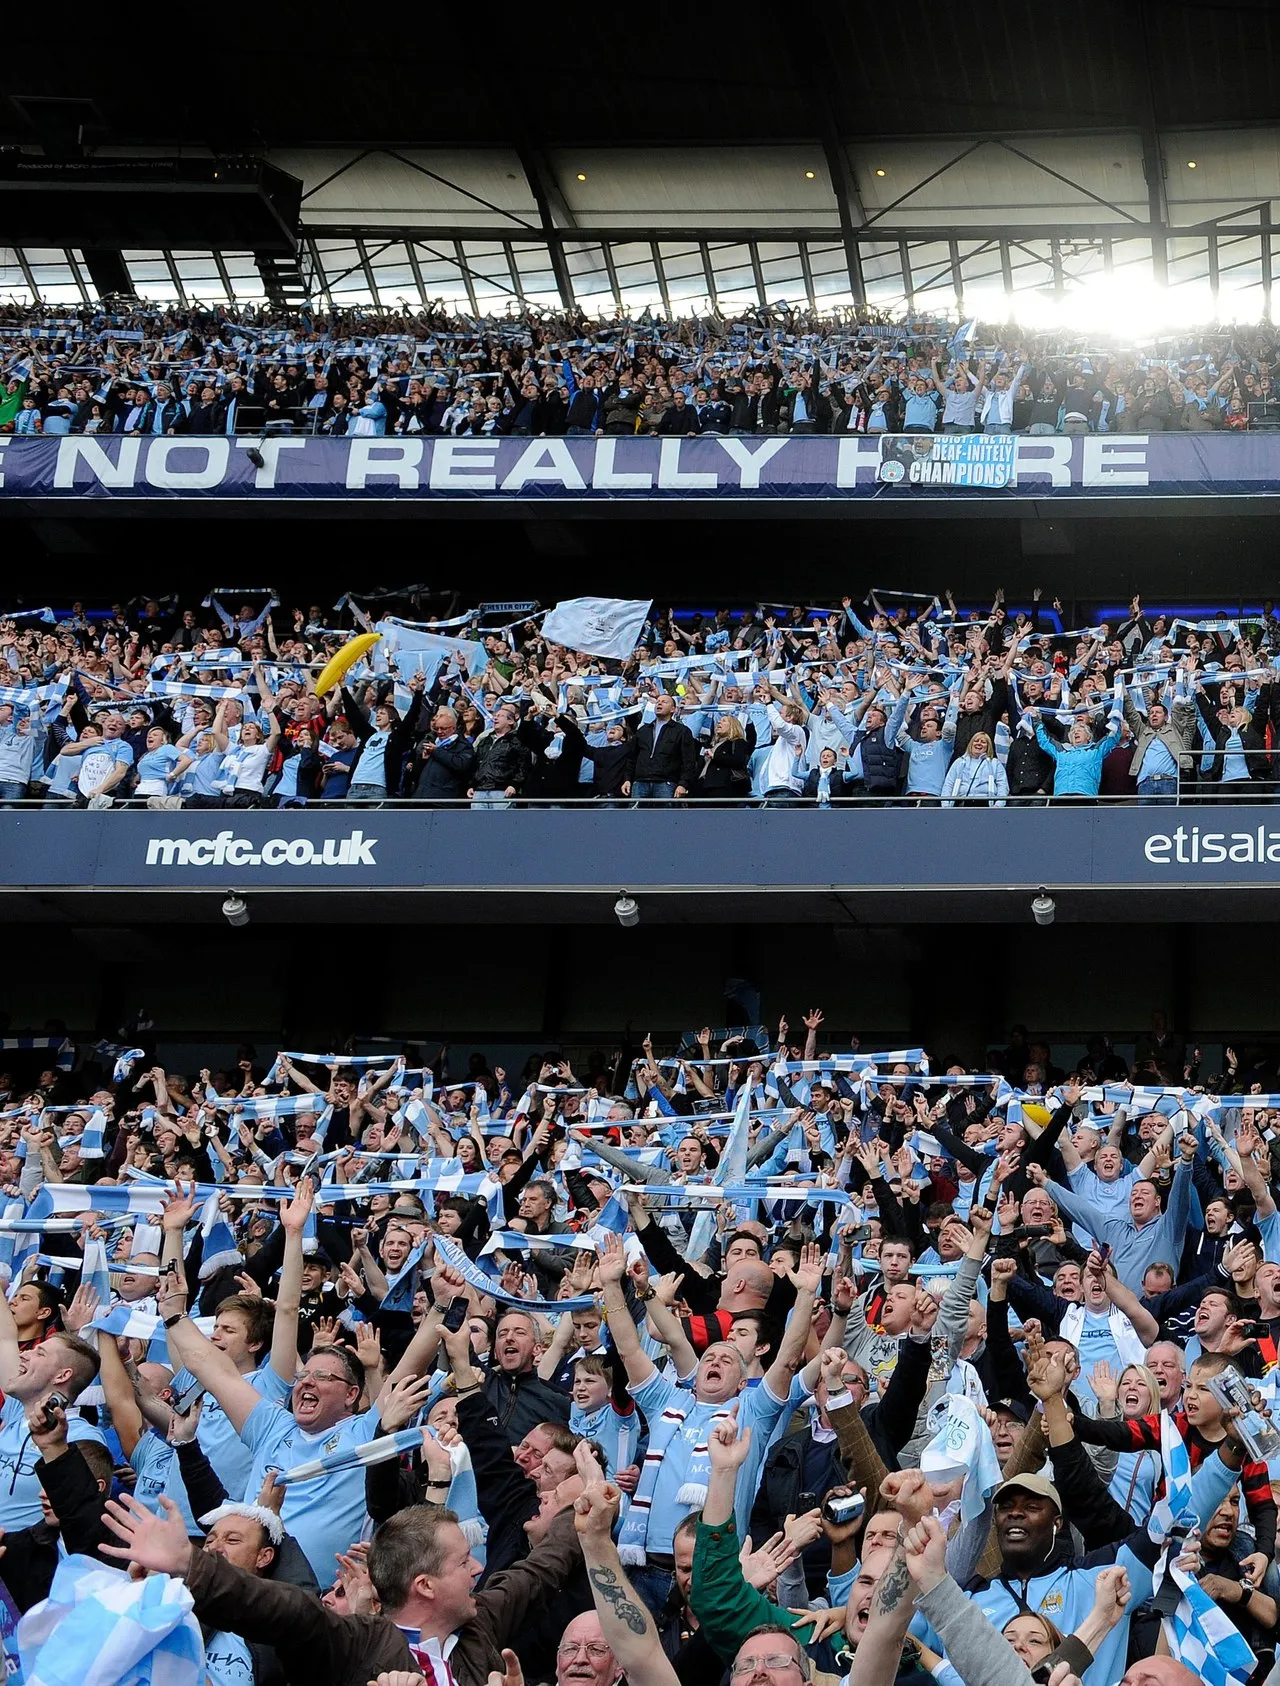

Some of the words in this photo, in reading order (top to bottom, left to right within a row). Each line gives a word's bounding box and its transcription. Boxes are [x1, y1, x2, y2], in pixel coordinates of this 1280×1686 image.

[53, 437, 306, 490] NOT
[345, 437, 791, 490] REALLY
[836, 434, 1150, 489] HRE
[932, 443, 1013, 462] DEAF-INITELY
[909, 461, 1011, 485] CHAMPIONS!
[145, 830, 378, 866] mcfc.co.uk
